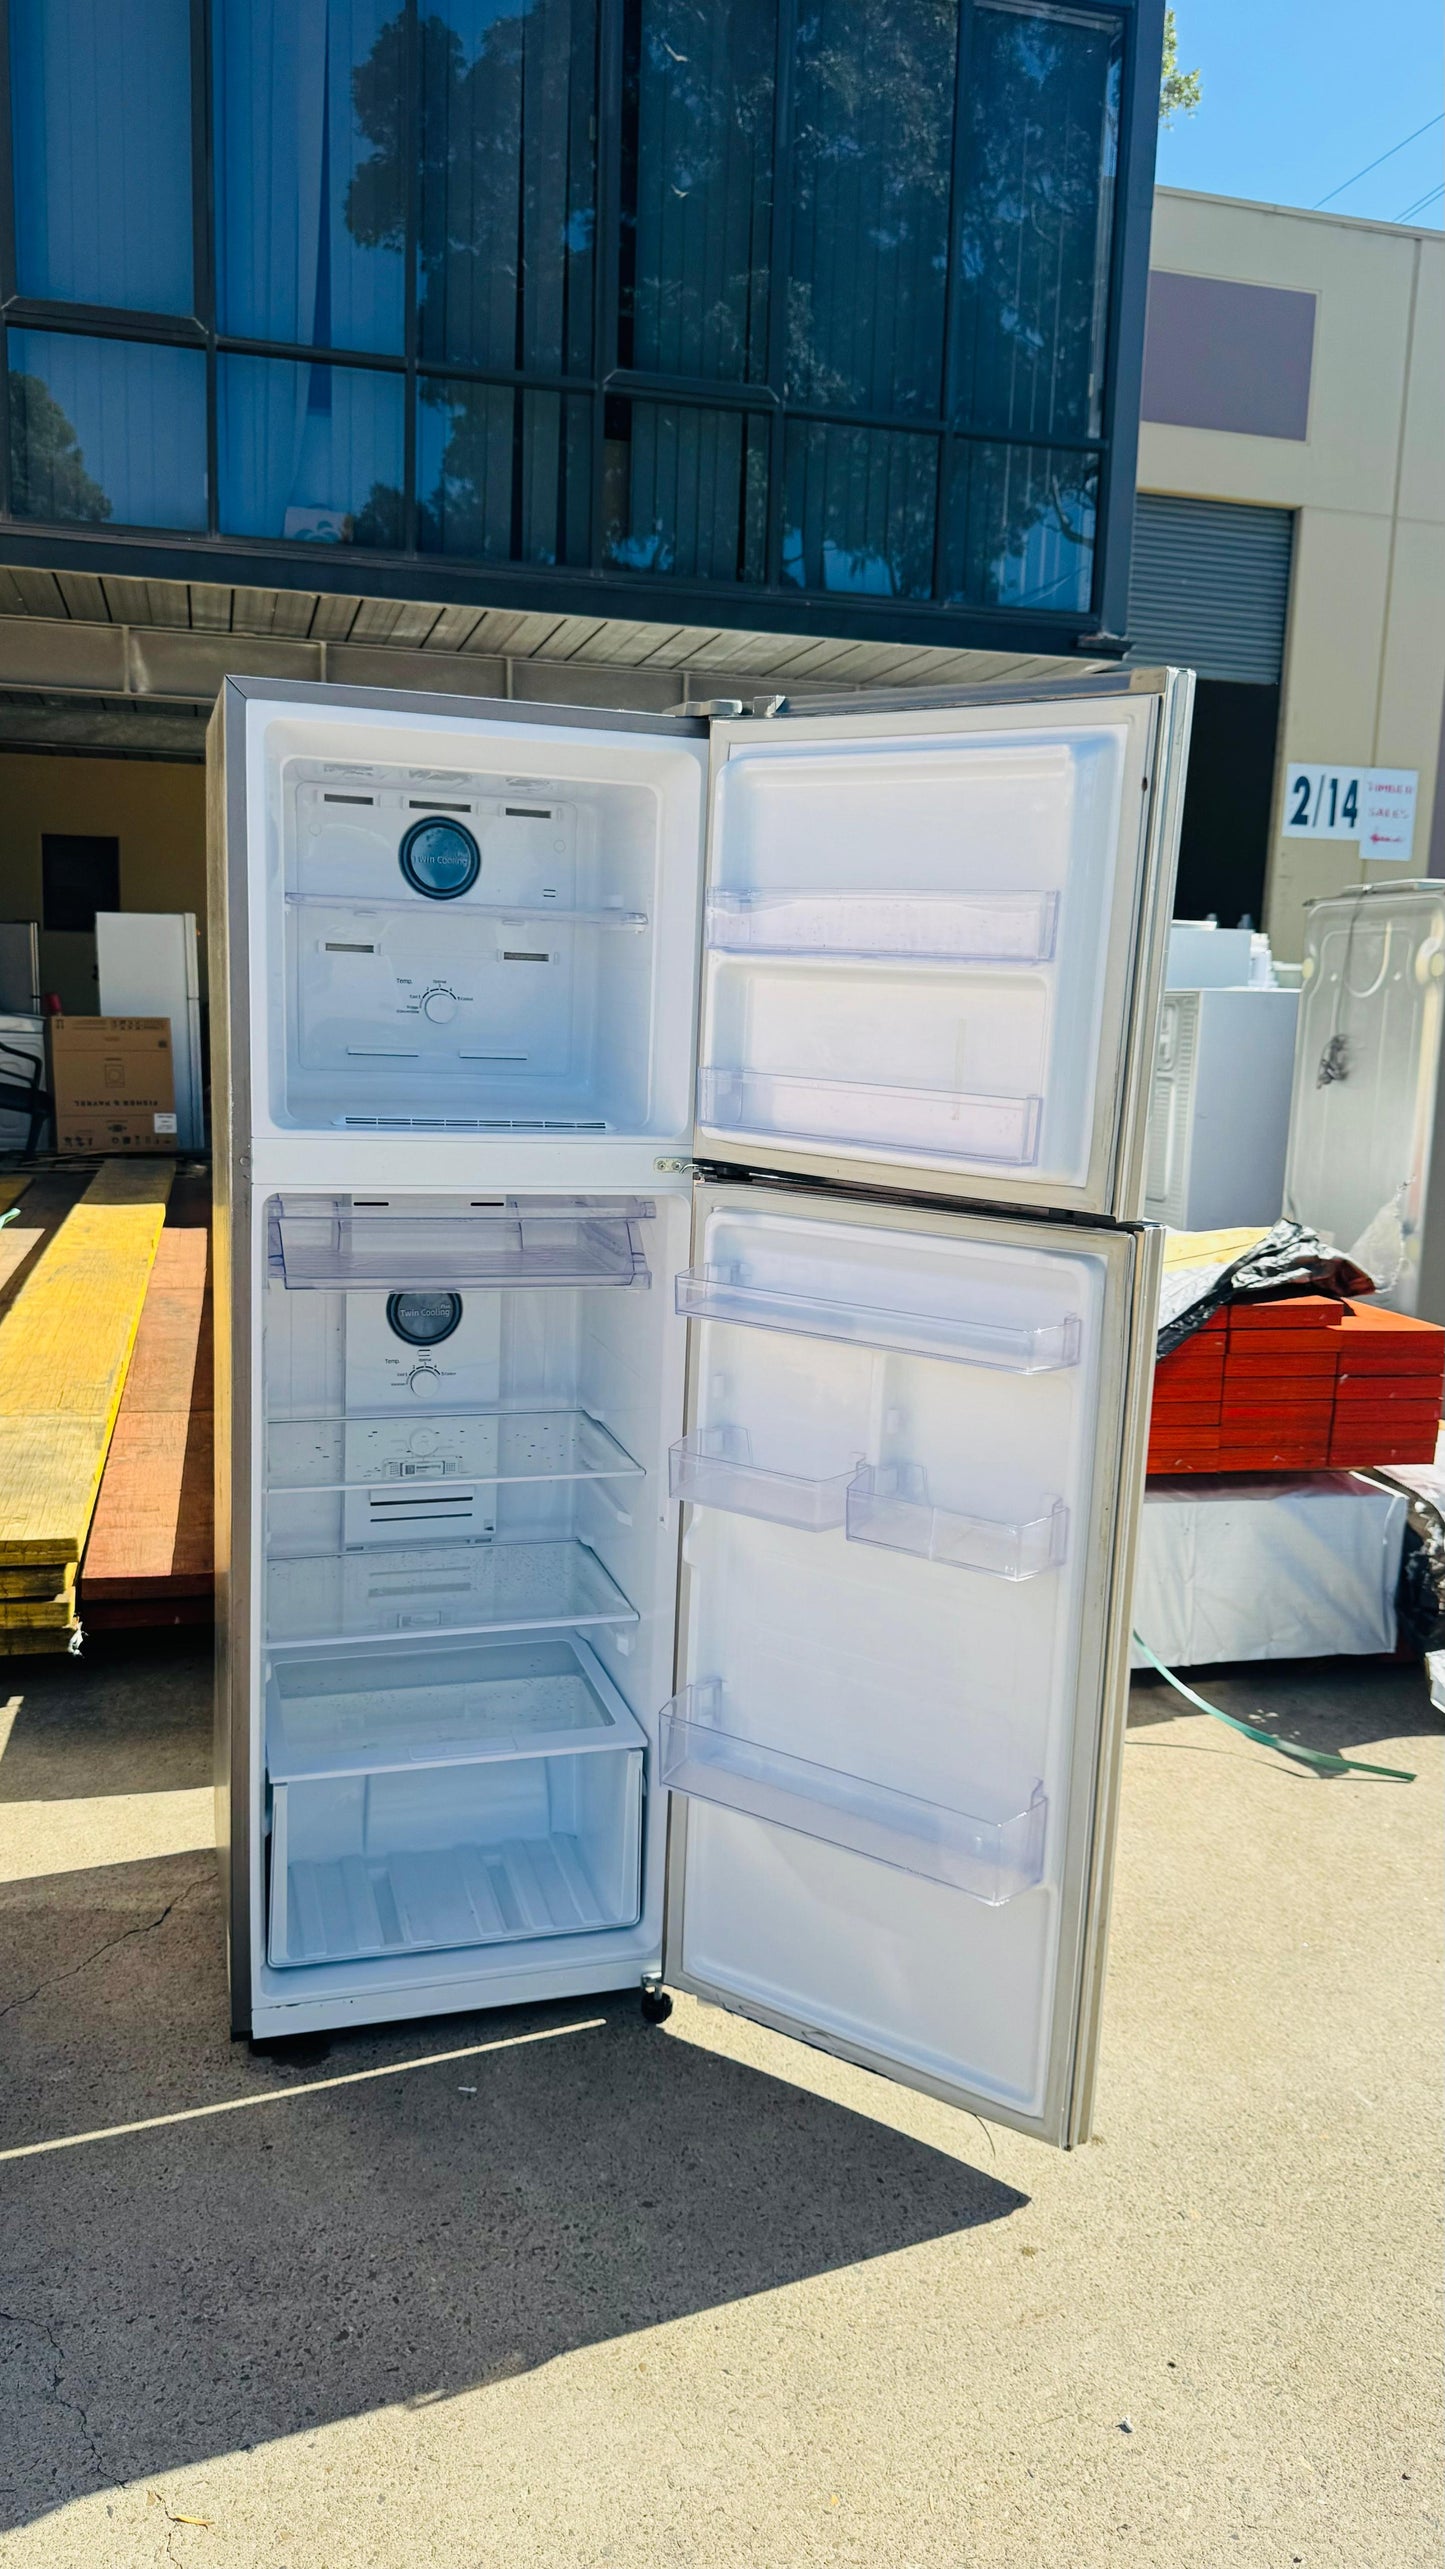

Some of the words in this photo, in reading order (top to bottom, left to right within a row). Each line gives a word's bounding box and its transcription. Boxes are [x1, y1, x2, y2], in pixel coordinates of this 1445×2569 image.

[1290, 774, 1358, 829] 2/14
[400, 1309, 420, 1317] Twin
[420, 1308, 450, 1318] Cooling
